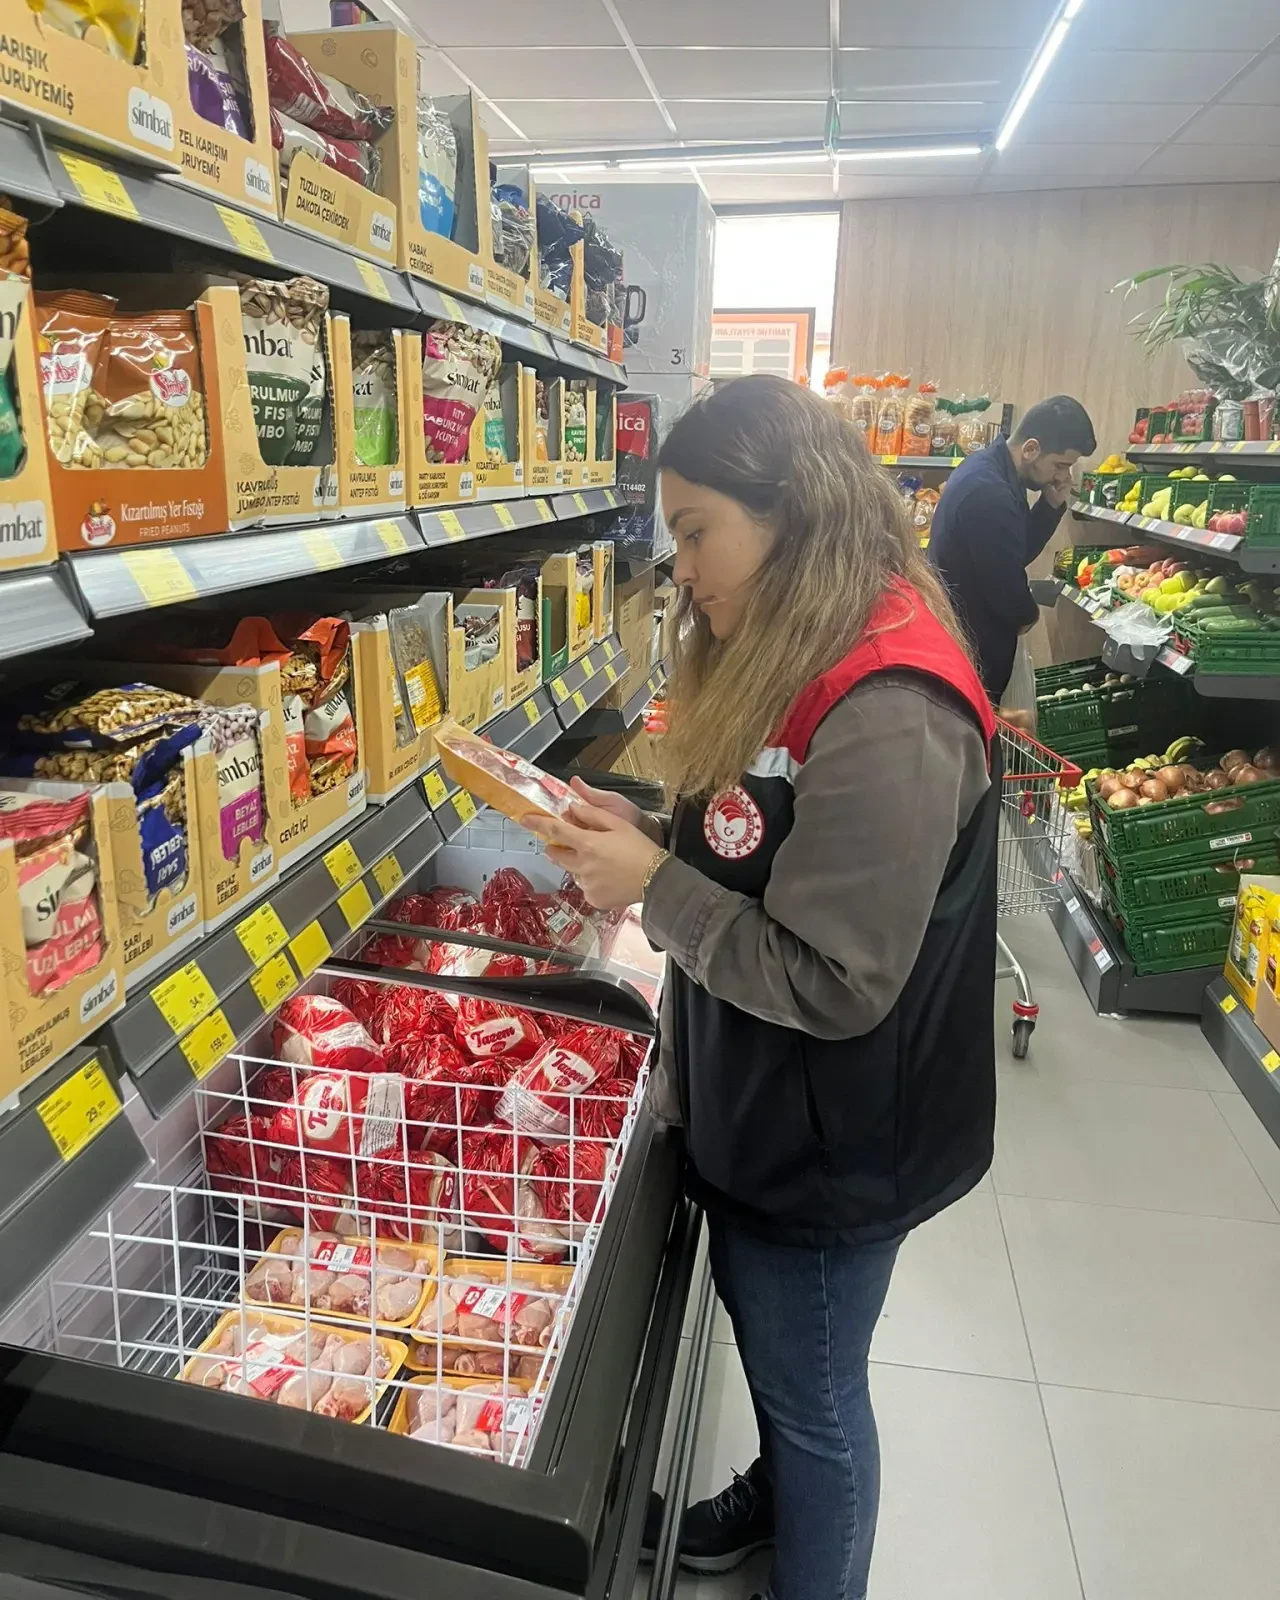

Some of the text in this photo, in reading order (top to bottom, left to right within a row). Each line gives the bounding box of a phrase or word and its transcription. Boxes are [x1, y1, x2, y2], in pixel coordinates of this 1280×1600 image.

[131, 101, 172, 139] simbat
[195, 135, 228, 163] KARIŞIM
[246, 168, 271, 196] simbat
[299, 177, 336, 206] TUZLU YERLİ
[296, 195, 350, 231] DAKOTA ÇEKİRDEK
[371, 217, 392, 243] simbat
[616, 412, 646, 431] ica
[120, 500, 168, 523] Kızartılmış
[168, 499, 181, 518] Yer
[139, 523, 190, 537] FRIED PEANUTS
[234, 799, 259, 821] BEYAZ
[279, 822, 300, 845] CEVİZ
[156, 863, 179, 885] SARI
[251, 852, 274, 878] simbat
[216, 873, 237, 894] BEYAZ
[168, 900, 196, 930] simbat
[123, 931, 142, 951] SARI
[82, 978, 117, 1018] simbat
[16, 1006, 71, 1048] KAVRULMUŞ
[470, 1026, 516, 1048] Tazem
[18, 1034, 48, 1062] TUZLU
